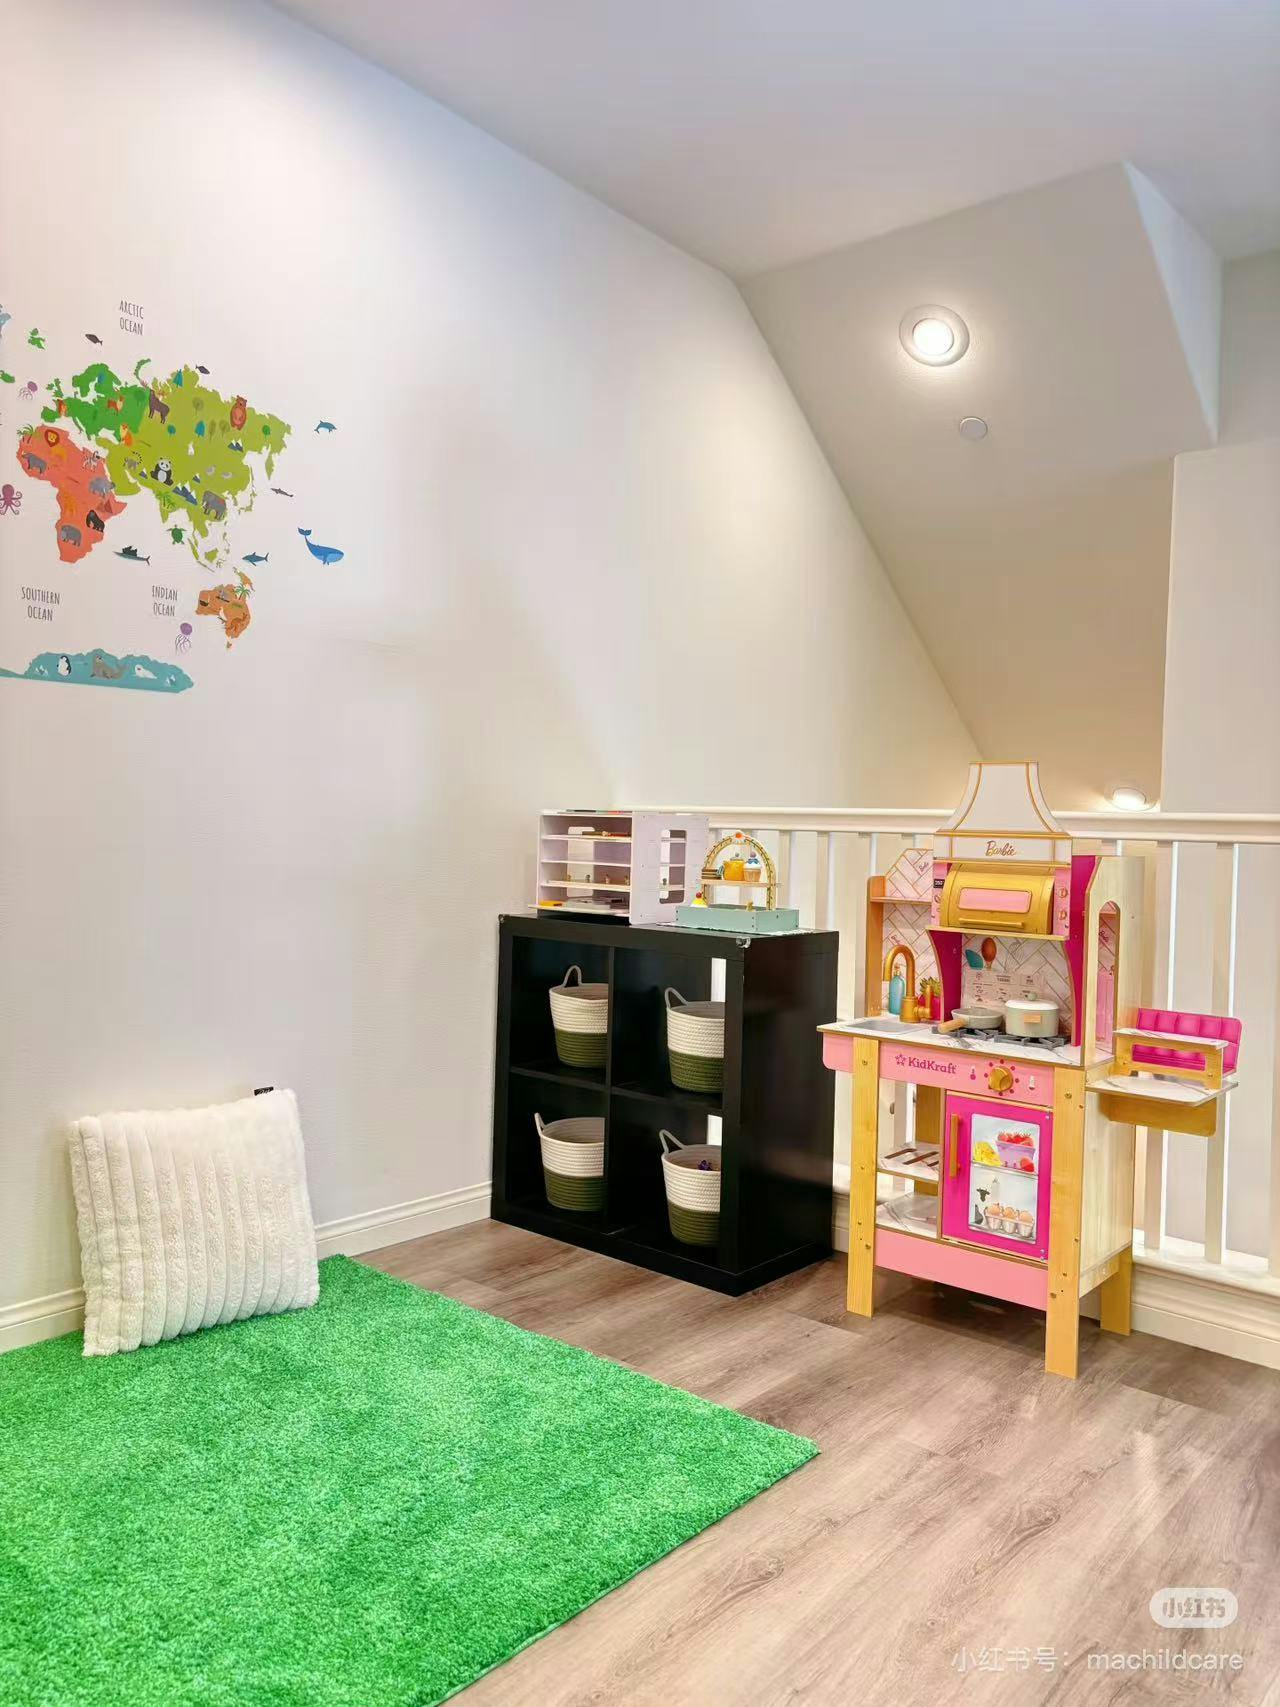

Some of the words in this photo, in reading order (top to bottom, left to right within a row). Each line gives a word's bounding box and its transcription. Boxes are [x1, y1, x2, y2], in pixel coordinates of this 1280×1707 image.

[119, 300, 144, 320] ARCTIC
[119, 317, 144, 335] OCEAN
[21, 586, 61, 605] SOUTHERN
[151, 585, 178, 601] INDIAN
[27, 605, 53, 621] OCEAN
[153, 602, 176, 617] OCEAN
[985, 840, 1016, 857] Barbie
[908, 1056, 957, 1074] KidKraft
